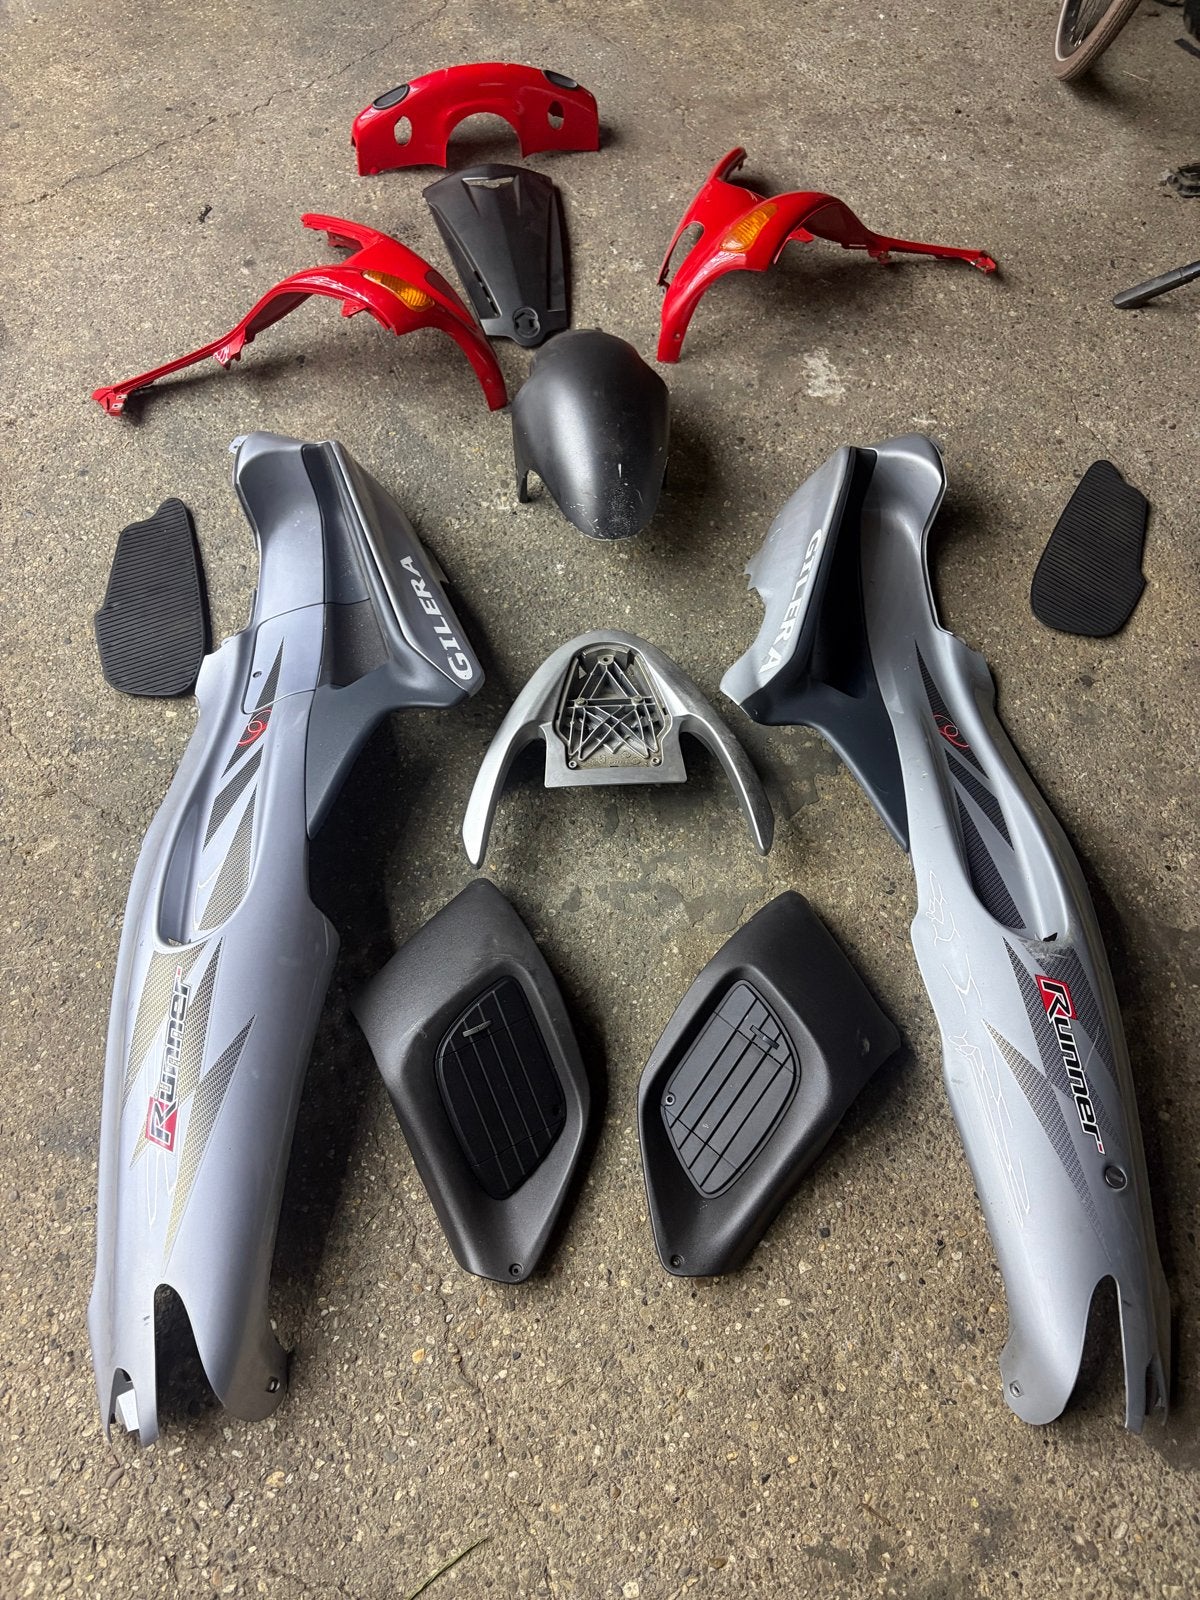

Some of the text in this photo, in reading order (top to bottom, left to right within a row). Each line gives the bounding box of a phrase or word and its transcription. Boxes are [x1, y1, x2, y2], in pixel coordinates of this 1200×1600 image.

[400, 555, 473, 680] GILERA
[759, 528, 822, 673] GILERA
[148, 971, 191, 1146] Runner
[1040, 977, 1103, 1147] Runner
